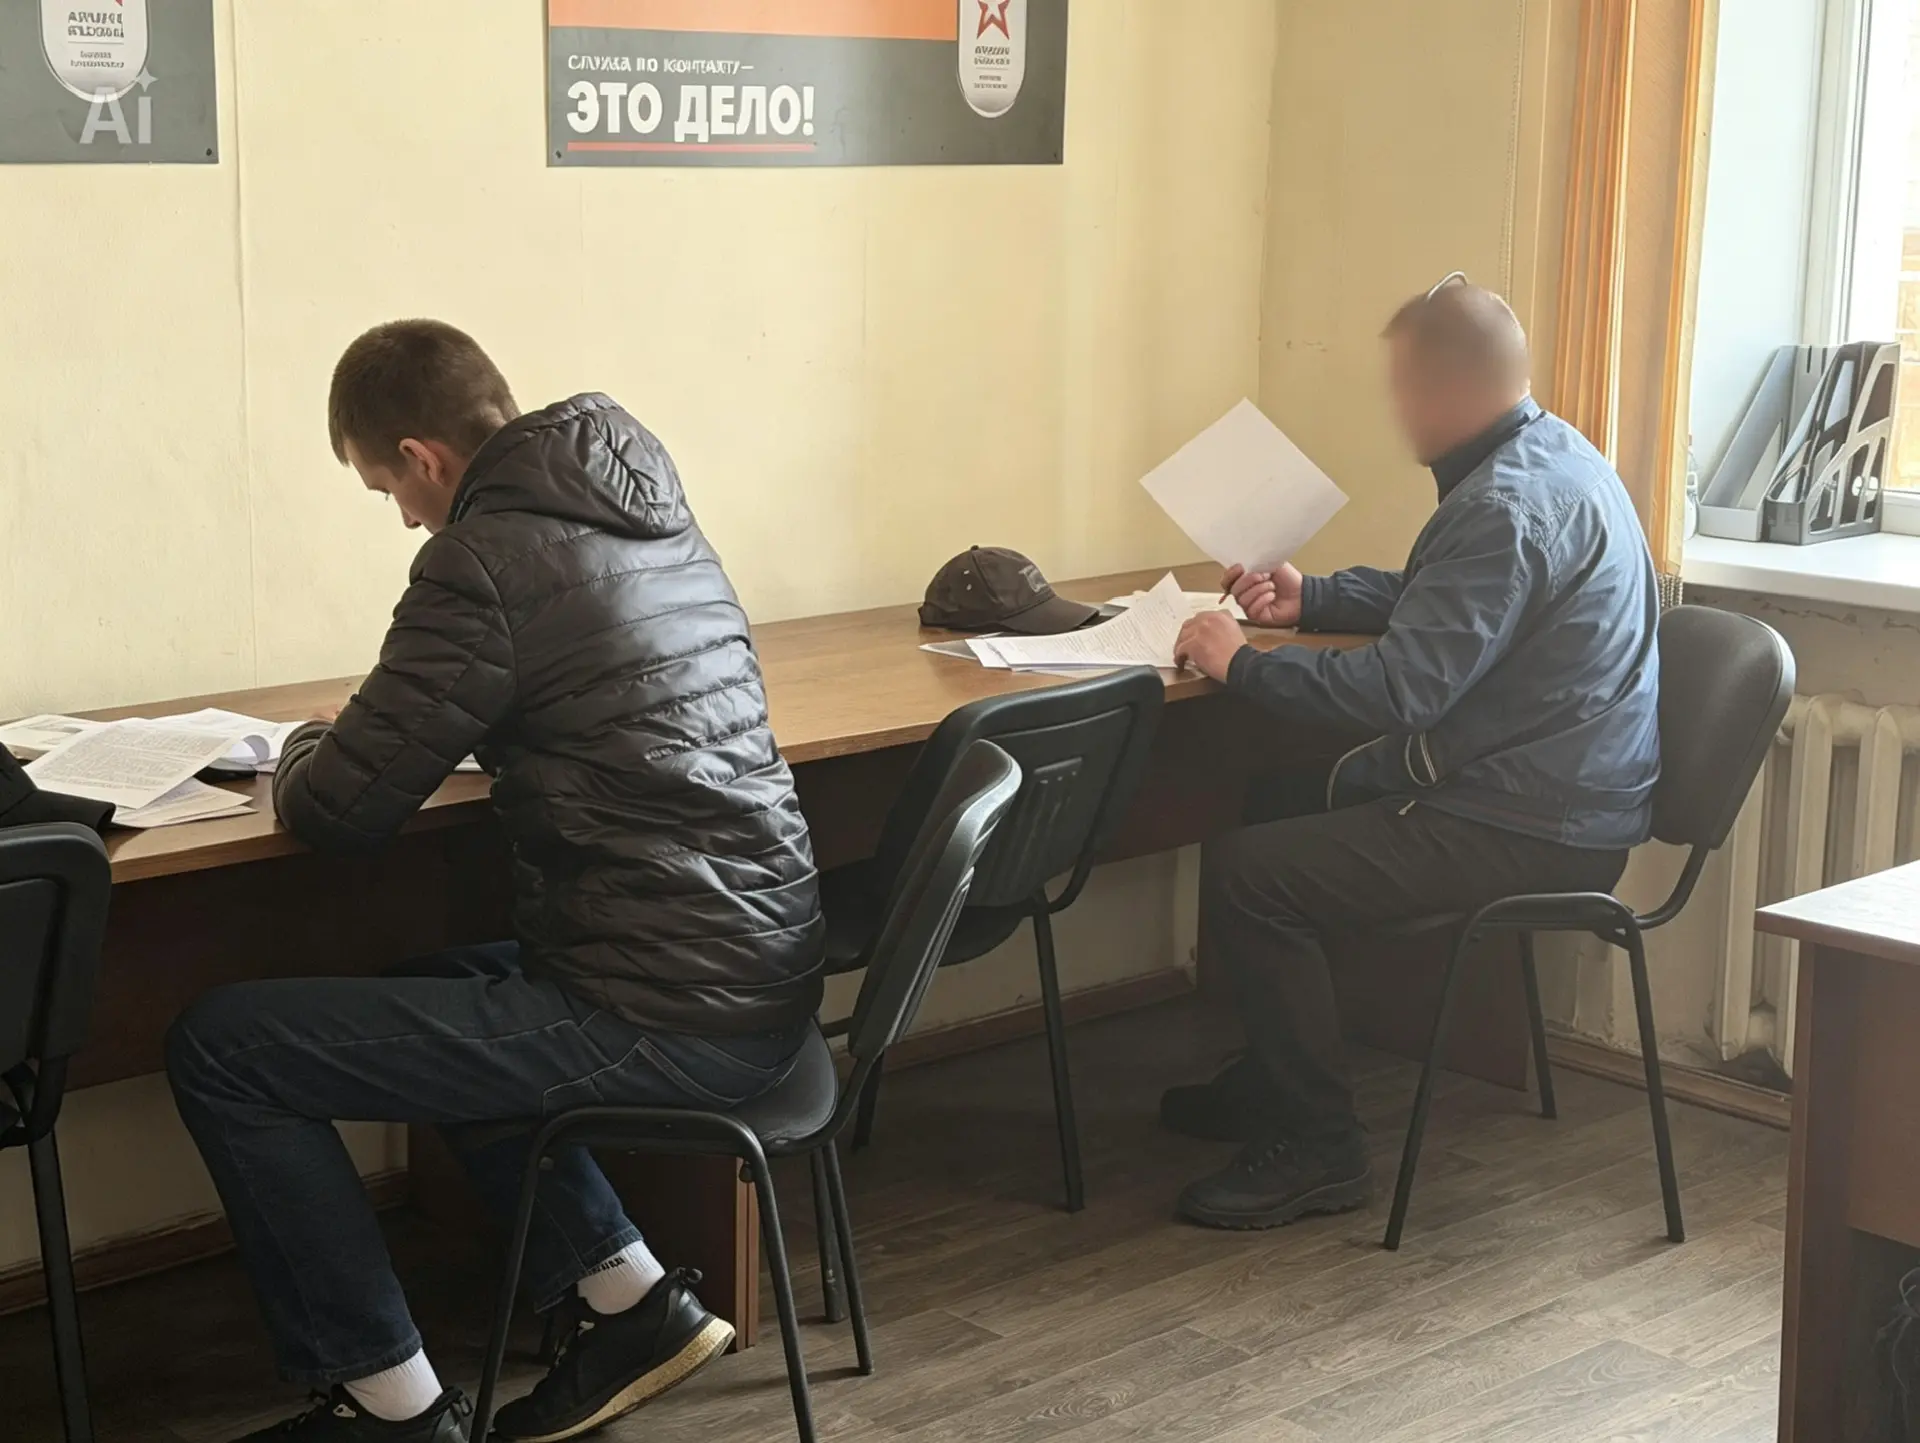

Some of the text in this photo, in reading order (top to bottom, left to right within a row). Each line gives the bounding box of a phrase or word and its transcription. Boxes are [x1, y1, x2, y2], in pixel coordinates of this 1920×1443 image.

[636, 57, 659, 73] ПО
[566, 80, 815, 143] ЭТО ДЕЛО!
